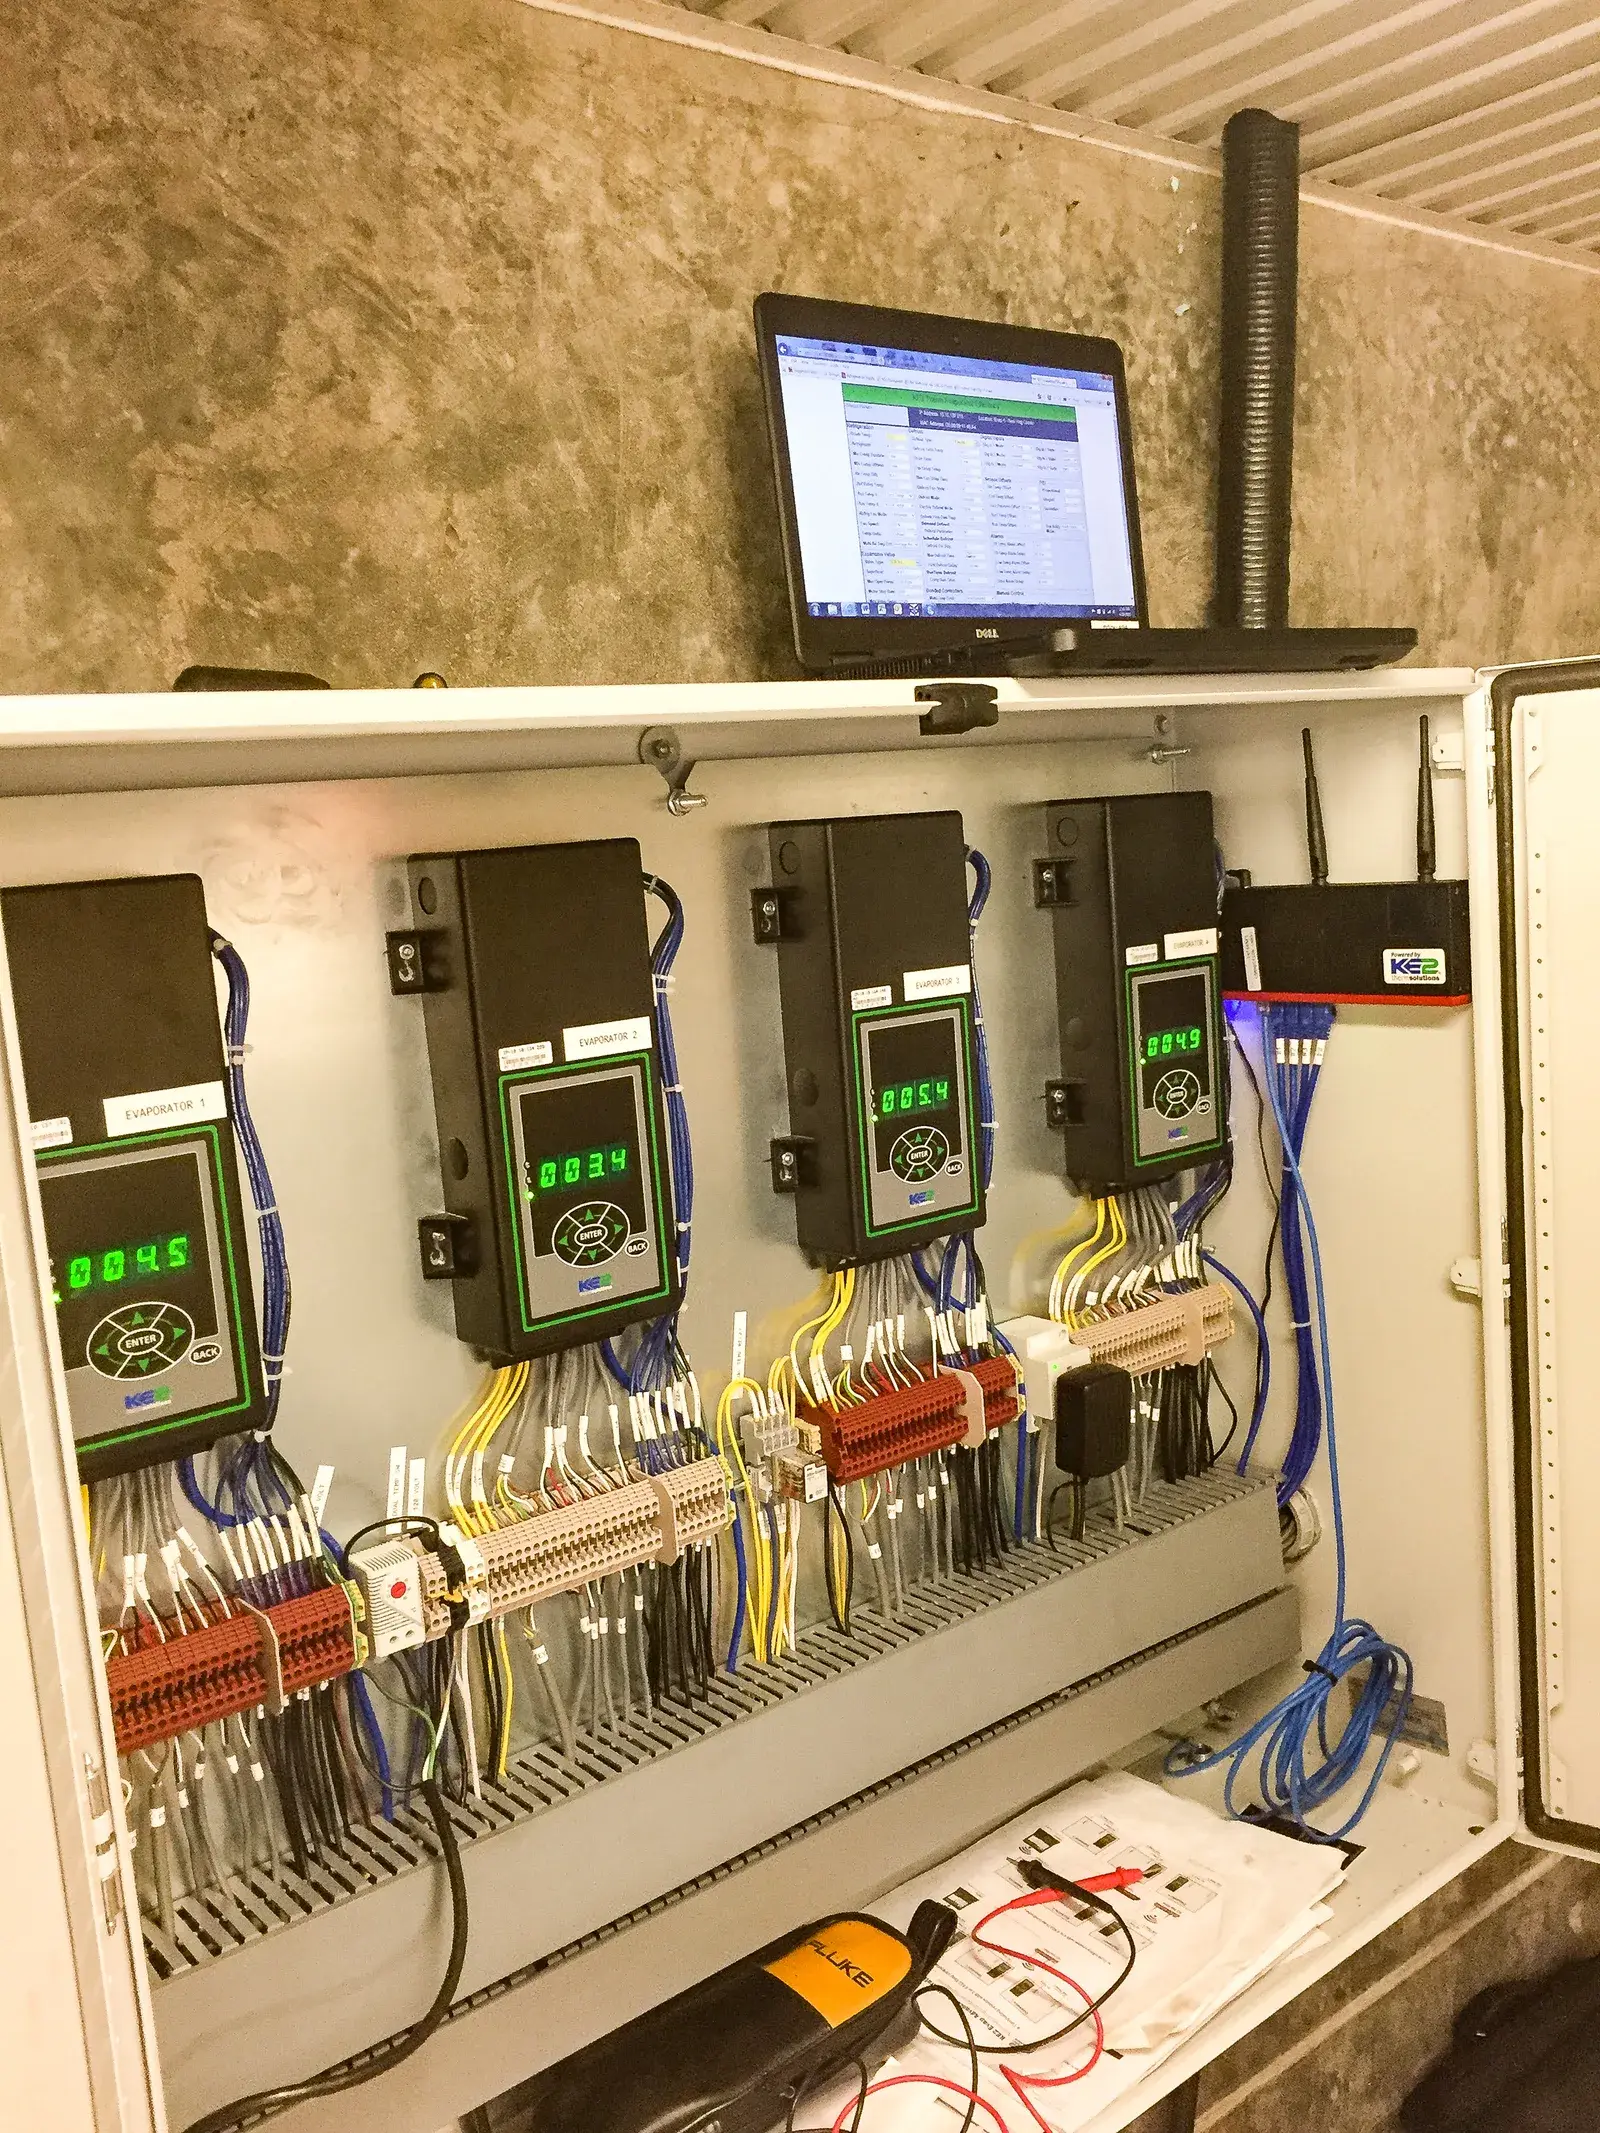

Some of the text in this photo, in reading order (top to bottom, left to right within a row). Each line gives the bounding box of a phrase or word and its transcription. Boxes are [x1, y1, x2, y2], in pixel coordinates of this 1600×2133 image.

[976, 628, 999, 639] DELL
[1390, 958, 1439, 975] KE2
[915, 979, 953, 990] EVAPORATOR
[579, 1031, 638, 1048] EVAPORATOR 2
[125, 1098, 206, 1121] EVAPORATOR 1
[910, 1150, 928, 1160] ENTER
[946, 1163, 962, 1173] BACK
[579, 1228, 603, 1241] ENTER
[628, 1242, 647, 1253] BACK
[125, 1333, 157, 1348] ENTER
[192, 1346, 218, 1361] BACK
[807, 1940, 874, 1988] FLUKE
